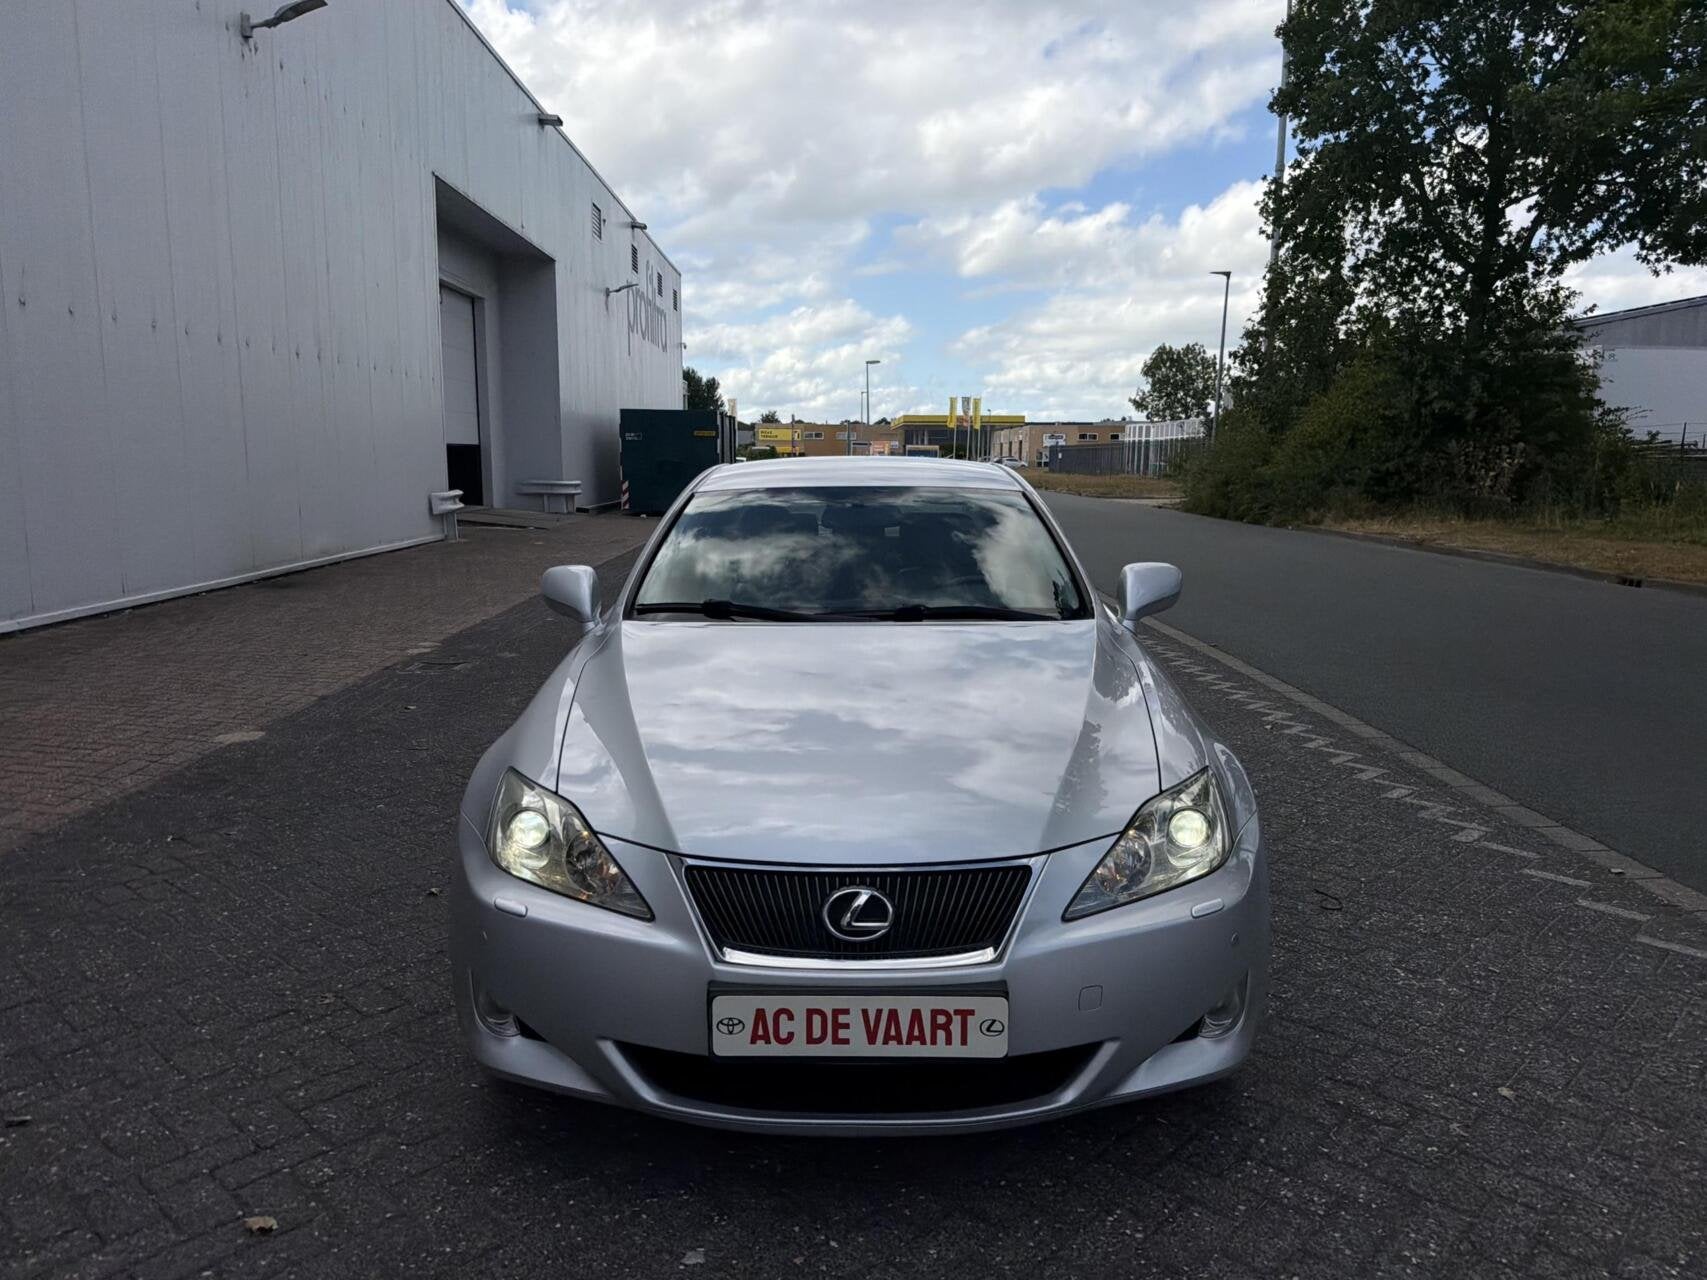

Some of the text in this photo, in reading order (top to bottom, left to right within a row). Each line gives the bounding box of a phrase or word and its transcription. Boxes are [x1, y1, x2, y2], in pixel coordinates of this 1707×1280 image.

[749, 1007, 976, 1047] AC DE VAART
